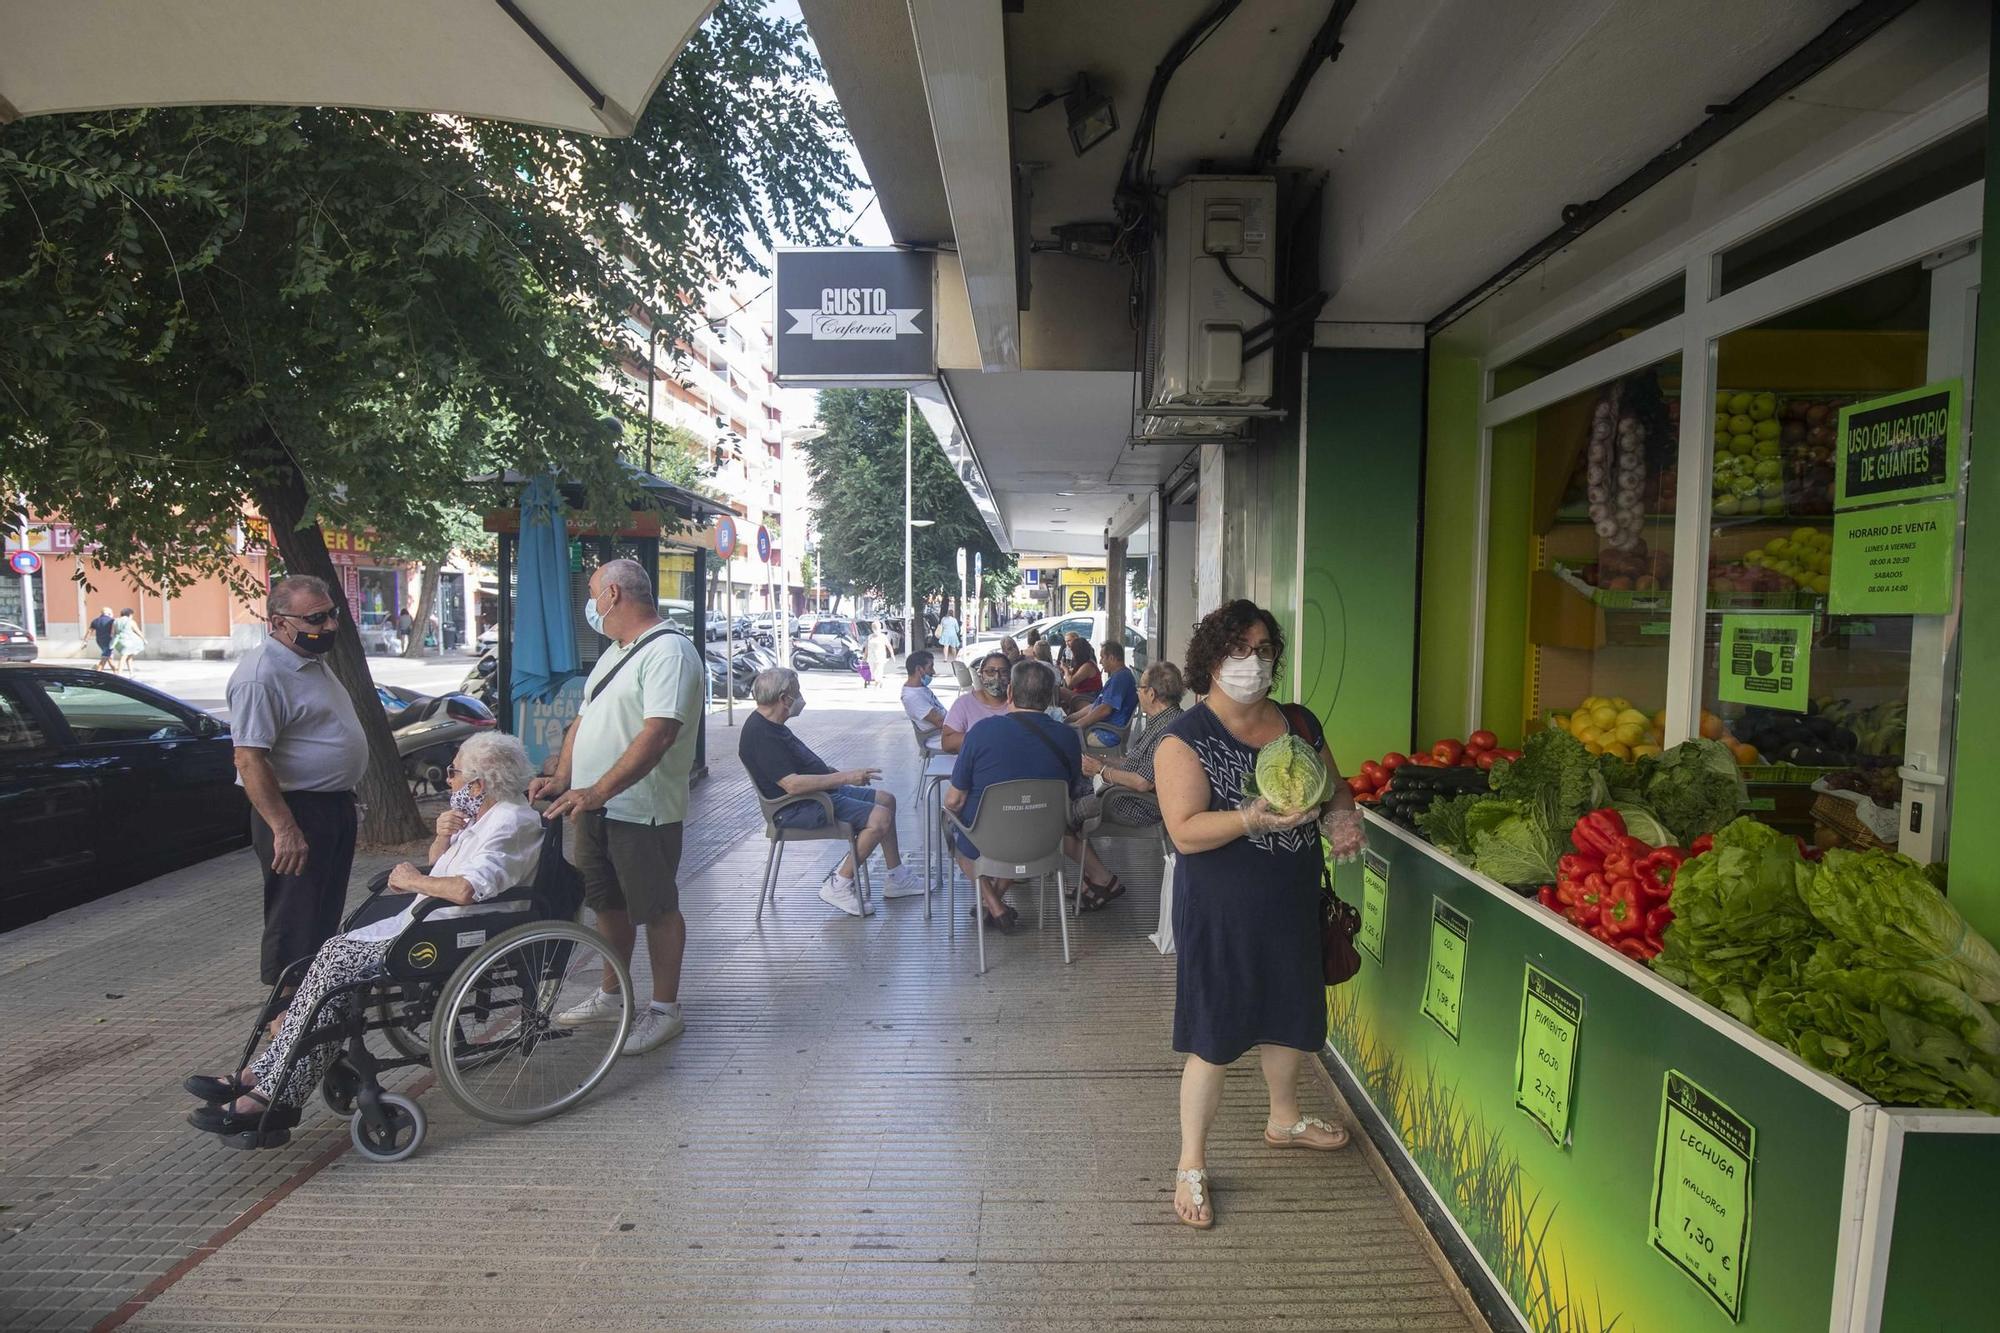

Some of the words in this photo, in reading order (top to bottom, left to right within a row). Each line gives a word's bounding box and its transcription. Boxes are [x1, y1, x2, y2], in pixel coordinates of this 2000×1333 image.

[821, 287, 887, 315] GUSTO
[816, 316, 893, 338] Cafetería
[1848, 425, 1870, 454] USO
[1871, 407, 1948, 449] OBLIGATORIO
[1860, 455, 1876, 482] DE
[1877, 445, 1930, 480] GUANTES
[323, 531, 349, 550] ER
[1848, 526, 1889, 540] HORARIO
[1890, 524, 1903, 535] DE
[1905, 520, 1937, 533] VENTA
[1864, 544, 1884, 553] LUNES
[1884, 543, 1890, 552] A
[1891, 541, 1917, 551] VIERNES
[1089, 575, 1105, 585] aut
[1534, 1008, 1568, 1043] PIMIENTO
[1538, 1047, 1560, 1072] ROJO
[1679, 1128, 1735, 1180] LECHUGA
[1682, 1176, 1727, 1218] MALLORCA
[1683, 1216, 1715, 1255] 1,30
[1721, 1254, 1731, 1272] €
